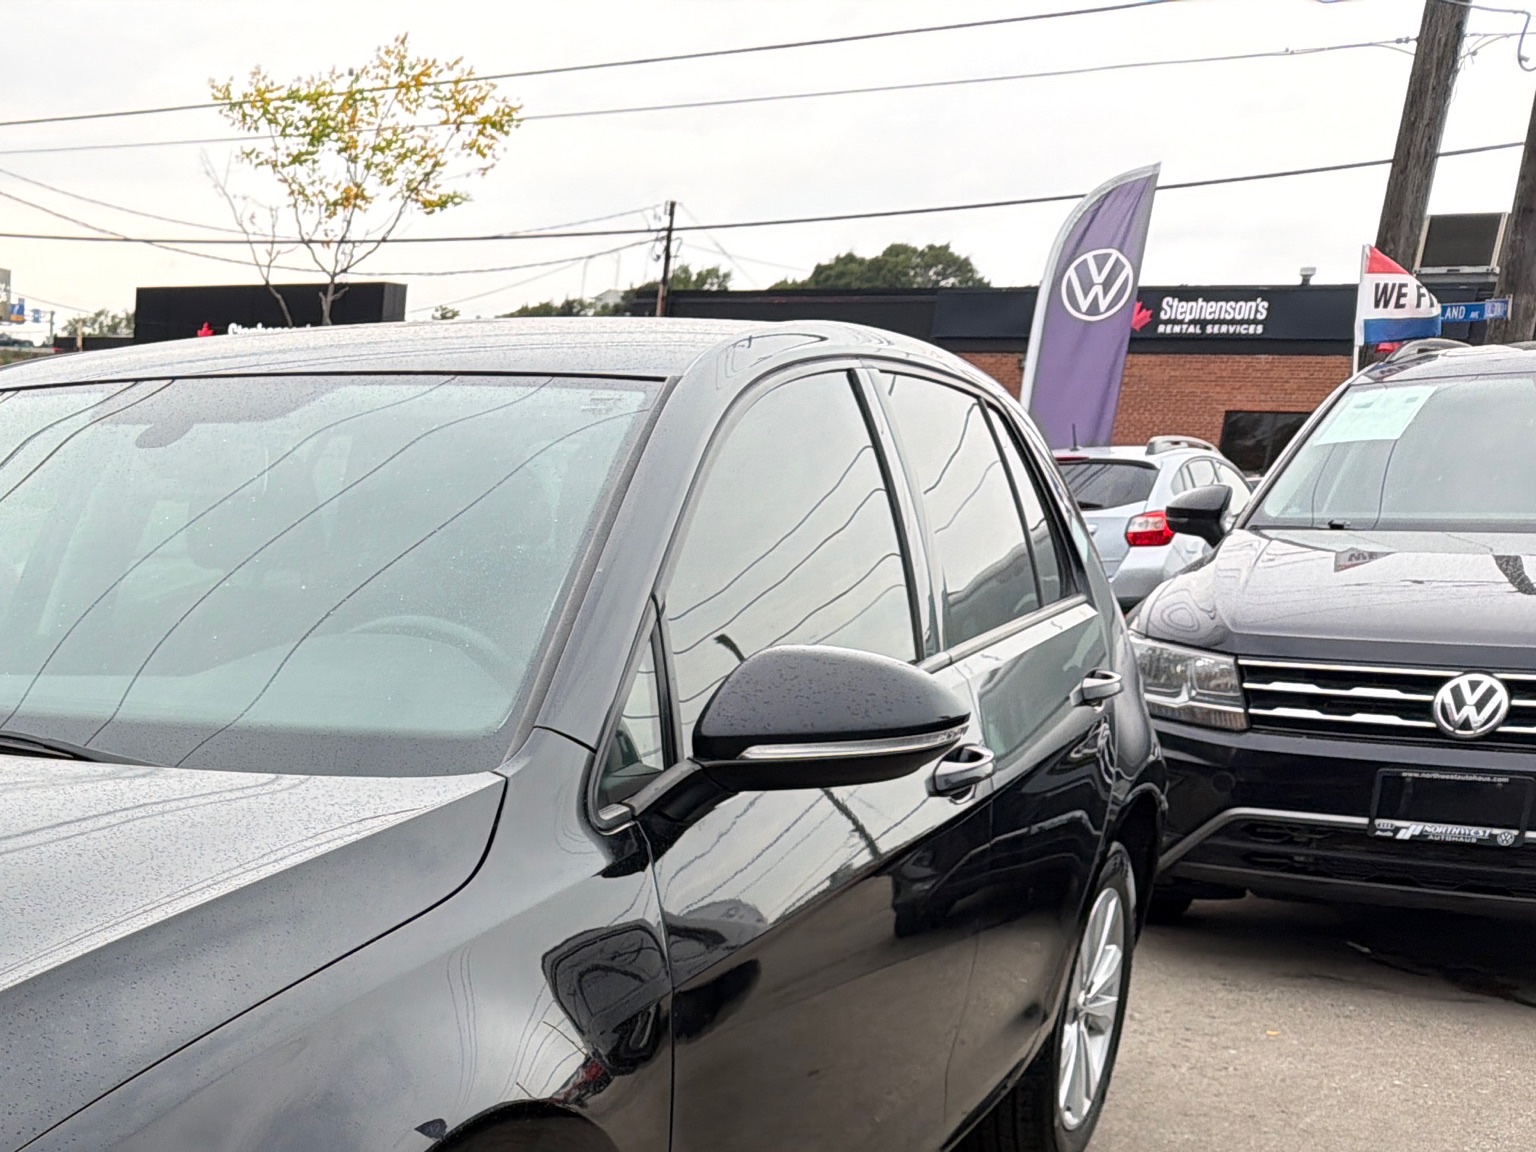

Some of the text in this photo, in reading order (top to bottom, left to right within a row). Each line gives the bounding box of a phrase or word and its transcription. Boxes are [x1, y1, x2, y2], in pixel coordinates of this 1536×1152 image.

[1061, 248, 1134, 322] VW
[1373, 282, 1409, 309] WE
[1159, 296, 1269, 322] Stephenson's
[1157, 324, 1264, 334] RENTAL SERVICES
[1434, 672, 1510, 738] VW
[1422, 824, 1493, 838] NORTHWEST
[1427, 834, 1478, 844] AUTOHAUS
